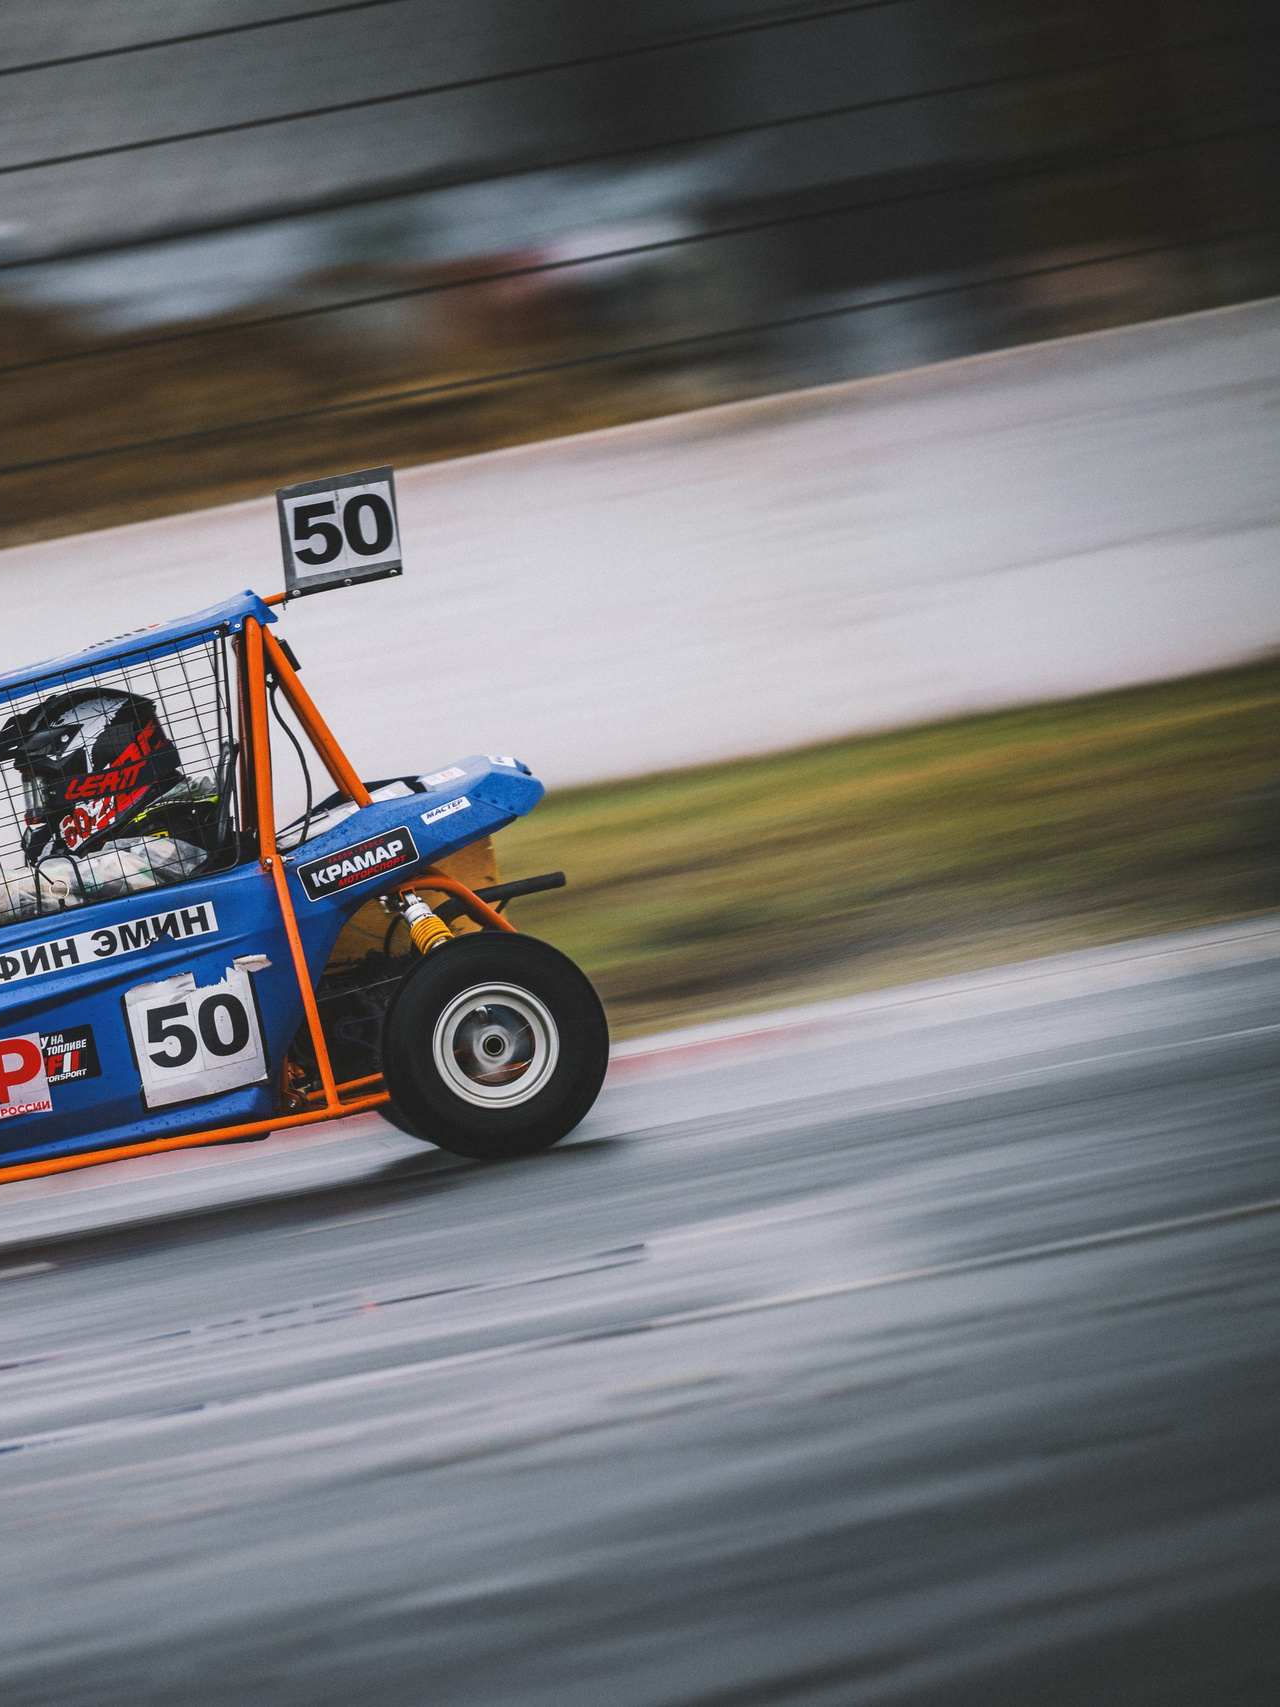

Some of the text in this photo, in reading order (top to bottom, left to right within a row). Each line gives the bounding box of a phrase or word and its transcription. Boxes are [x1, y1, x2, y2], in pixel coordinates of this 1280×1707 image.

[294, 493, 394, 566] 50
[425, 798, 464, 820] МАСТЕР
[310, 839, 404, 888] КРАМАР
[338, 854, 407, 888] МОТОРСПОРТ
[90, 905, 211, 957] ЭМИН
[47, 1038, 87, 1056] ТОПЛИВЕ
[51, 1034, 64, 1046] НА
[146, 993, 250, 1069] 50
[0, 1100, 51, 1117] РОССИИ
